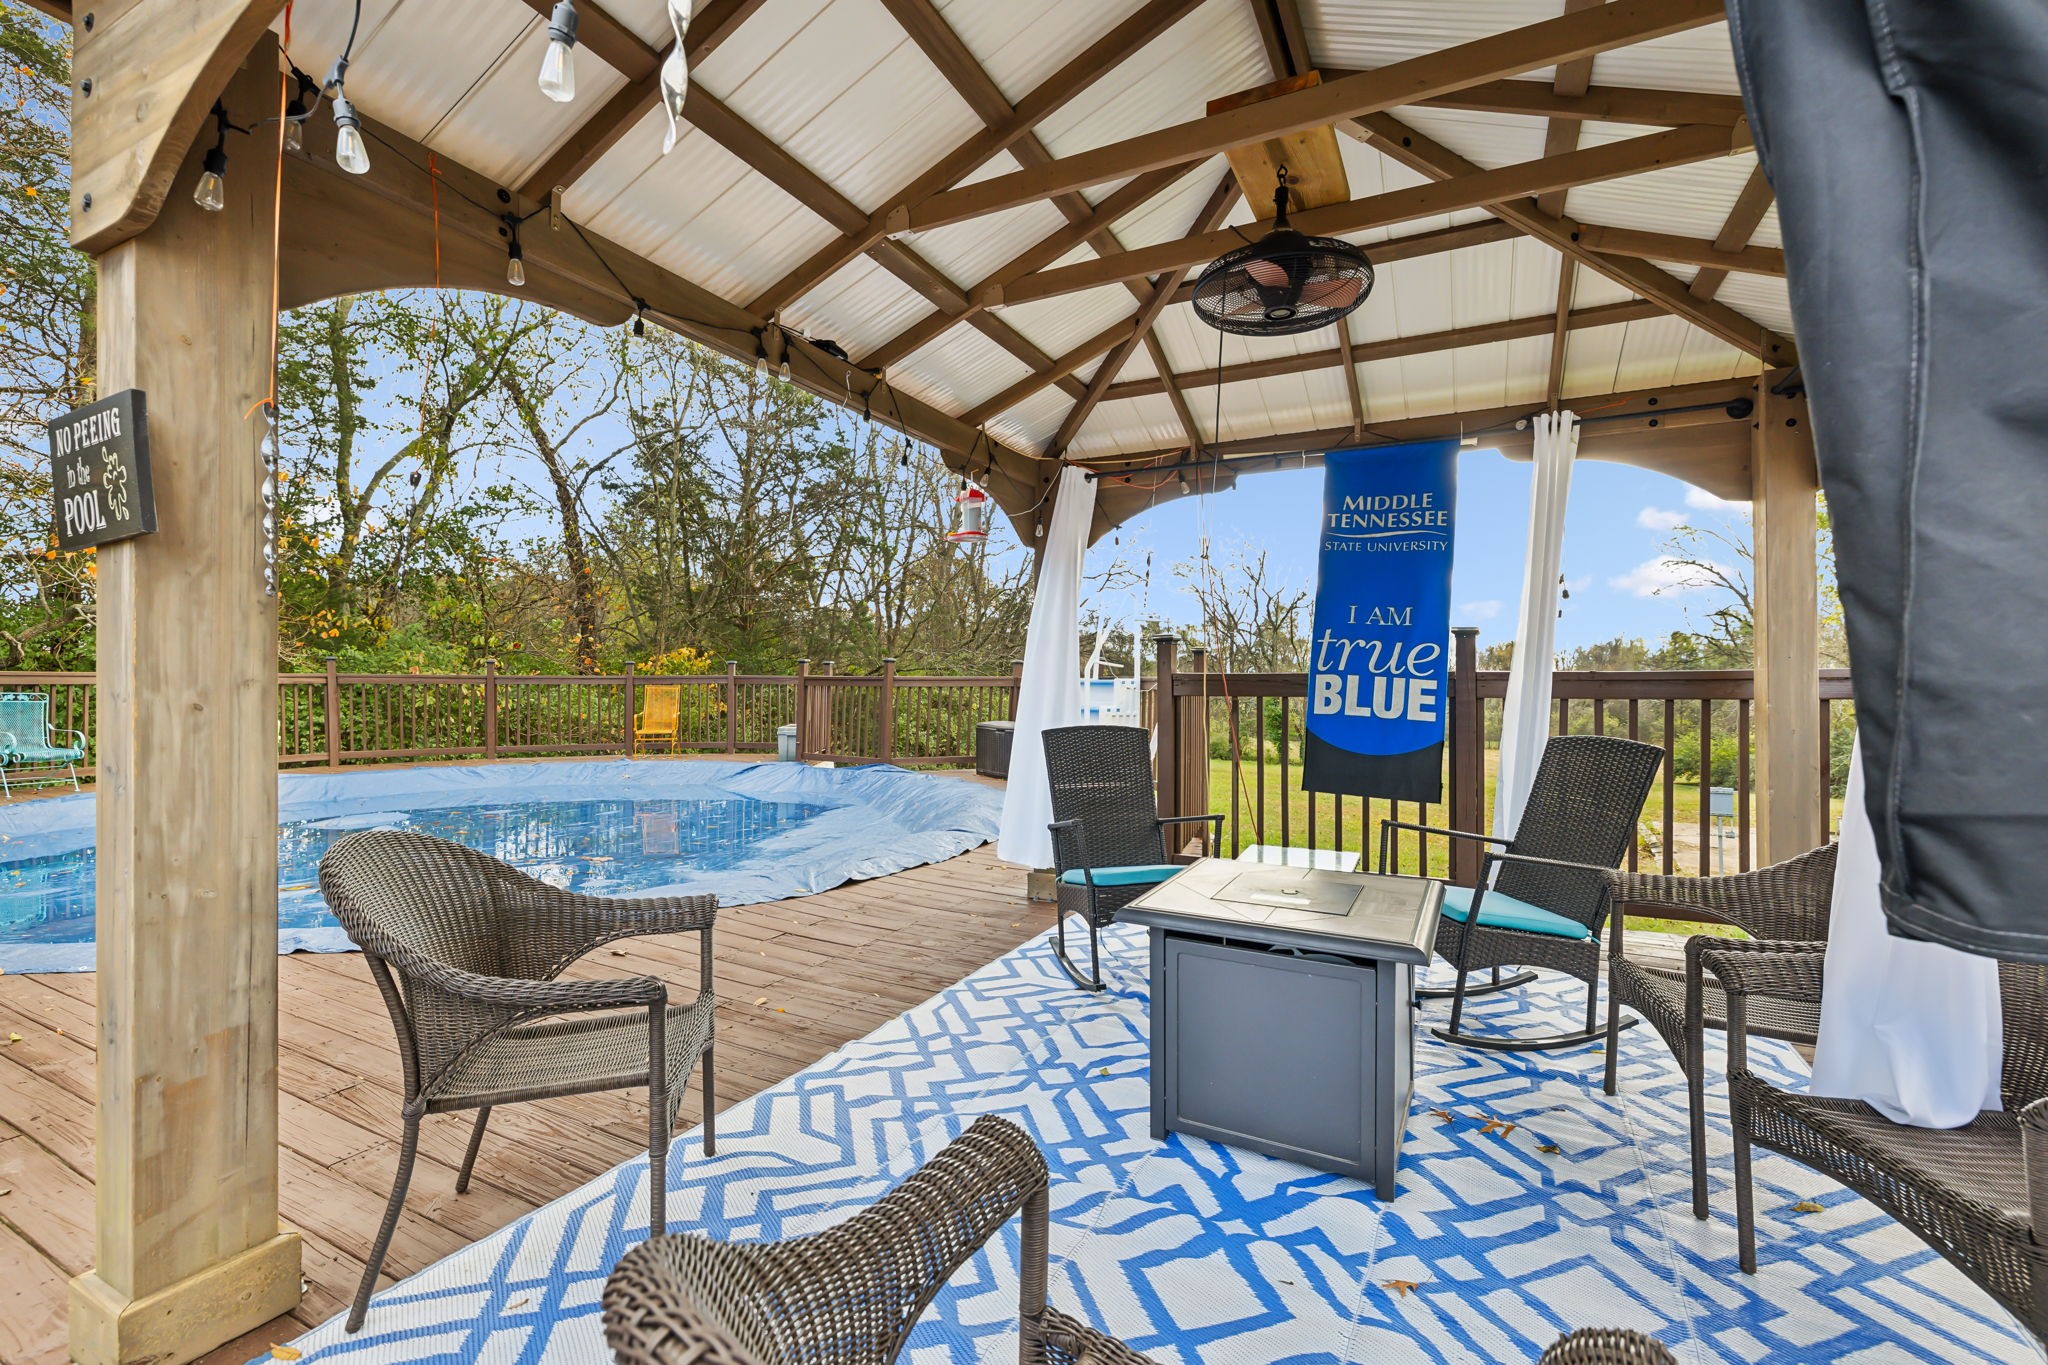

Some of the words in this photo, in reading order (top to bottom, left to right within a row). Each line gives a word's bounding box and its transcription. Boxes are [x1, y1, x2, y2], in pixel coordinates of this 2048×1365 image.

[55, 426, 73, 458] NO
[73, 407, 122, 451] PEEING
[66, 464, 76, 489] in
[77, 456, 91, 486] the
[63, 489, 107, 537] POOL
[1342, 492, 1433, 512] MIDDLE
[1327, 510, 1448, 529] TENNESSEE
[1324, 540, 1362, 553] STATE
[1367, 540, 1449, 552] UNIVERSITY
[1347, 605, 1358, 625] I
[1365, 606, 1414, 627] AM
[1316, 628, 1441, 678] true
[1313, 673, 1438, 723] BLUE
